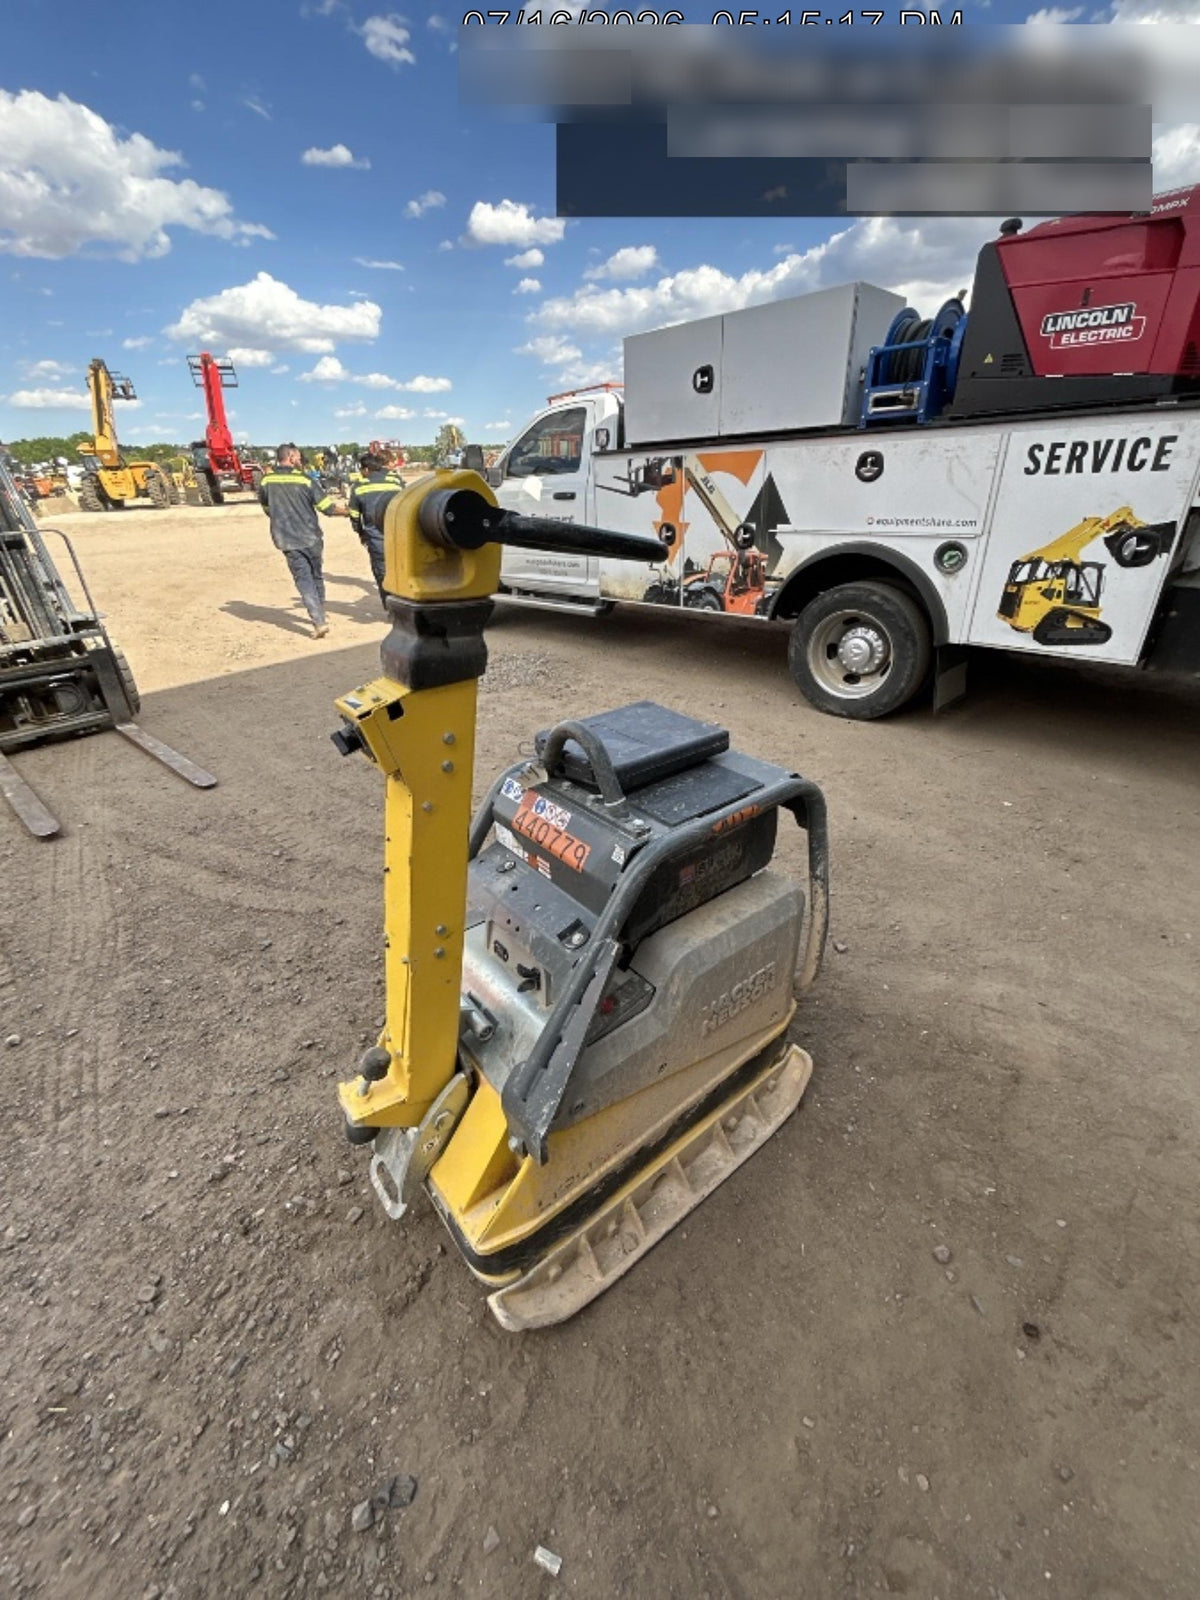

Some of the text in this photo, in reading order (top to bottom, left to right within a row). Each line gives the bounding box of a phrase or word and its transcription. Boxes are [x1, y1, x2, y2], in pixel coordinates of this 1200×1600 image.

[1046, 306, 1129, 333] LINCOLN
[1061, 325, 1134, 345] ELECTRIC
[1024, 435, 1179, 476] SERVICE
[876, 517, 978, 528] equipmentshare.com
[515, 810, 587, 870] 440779
